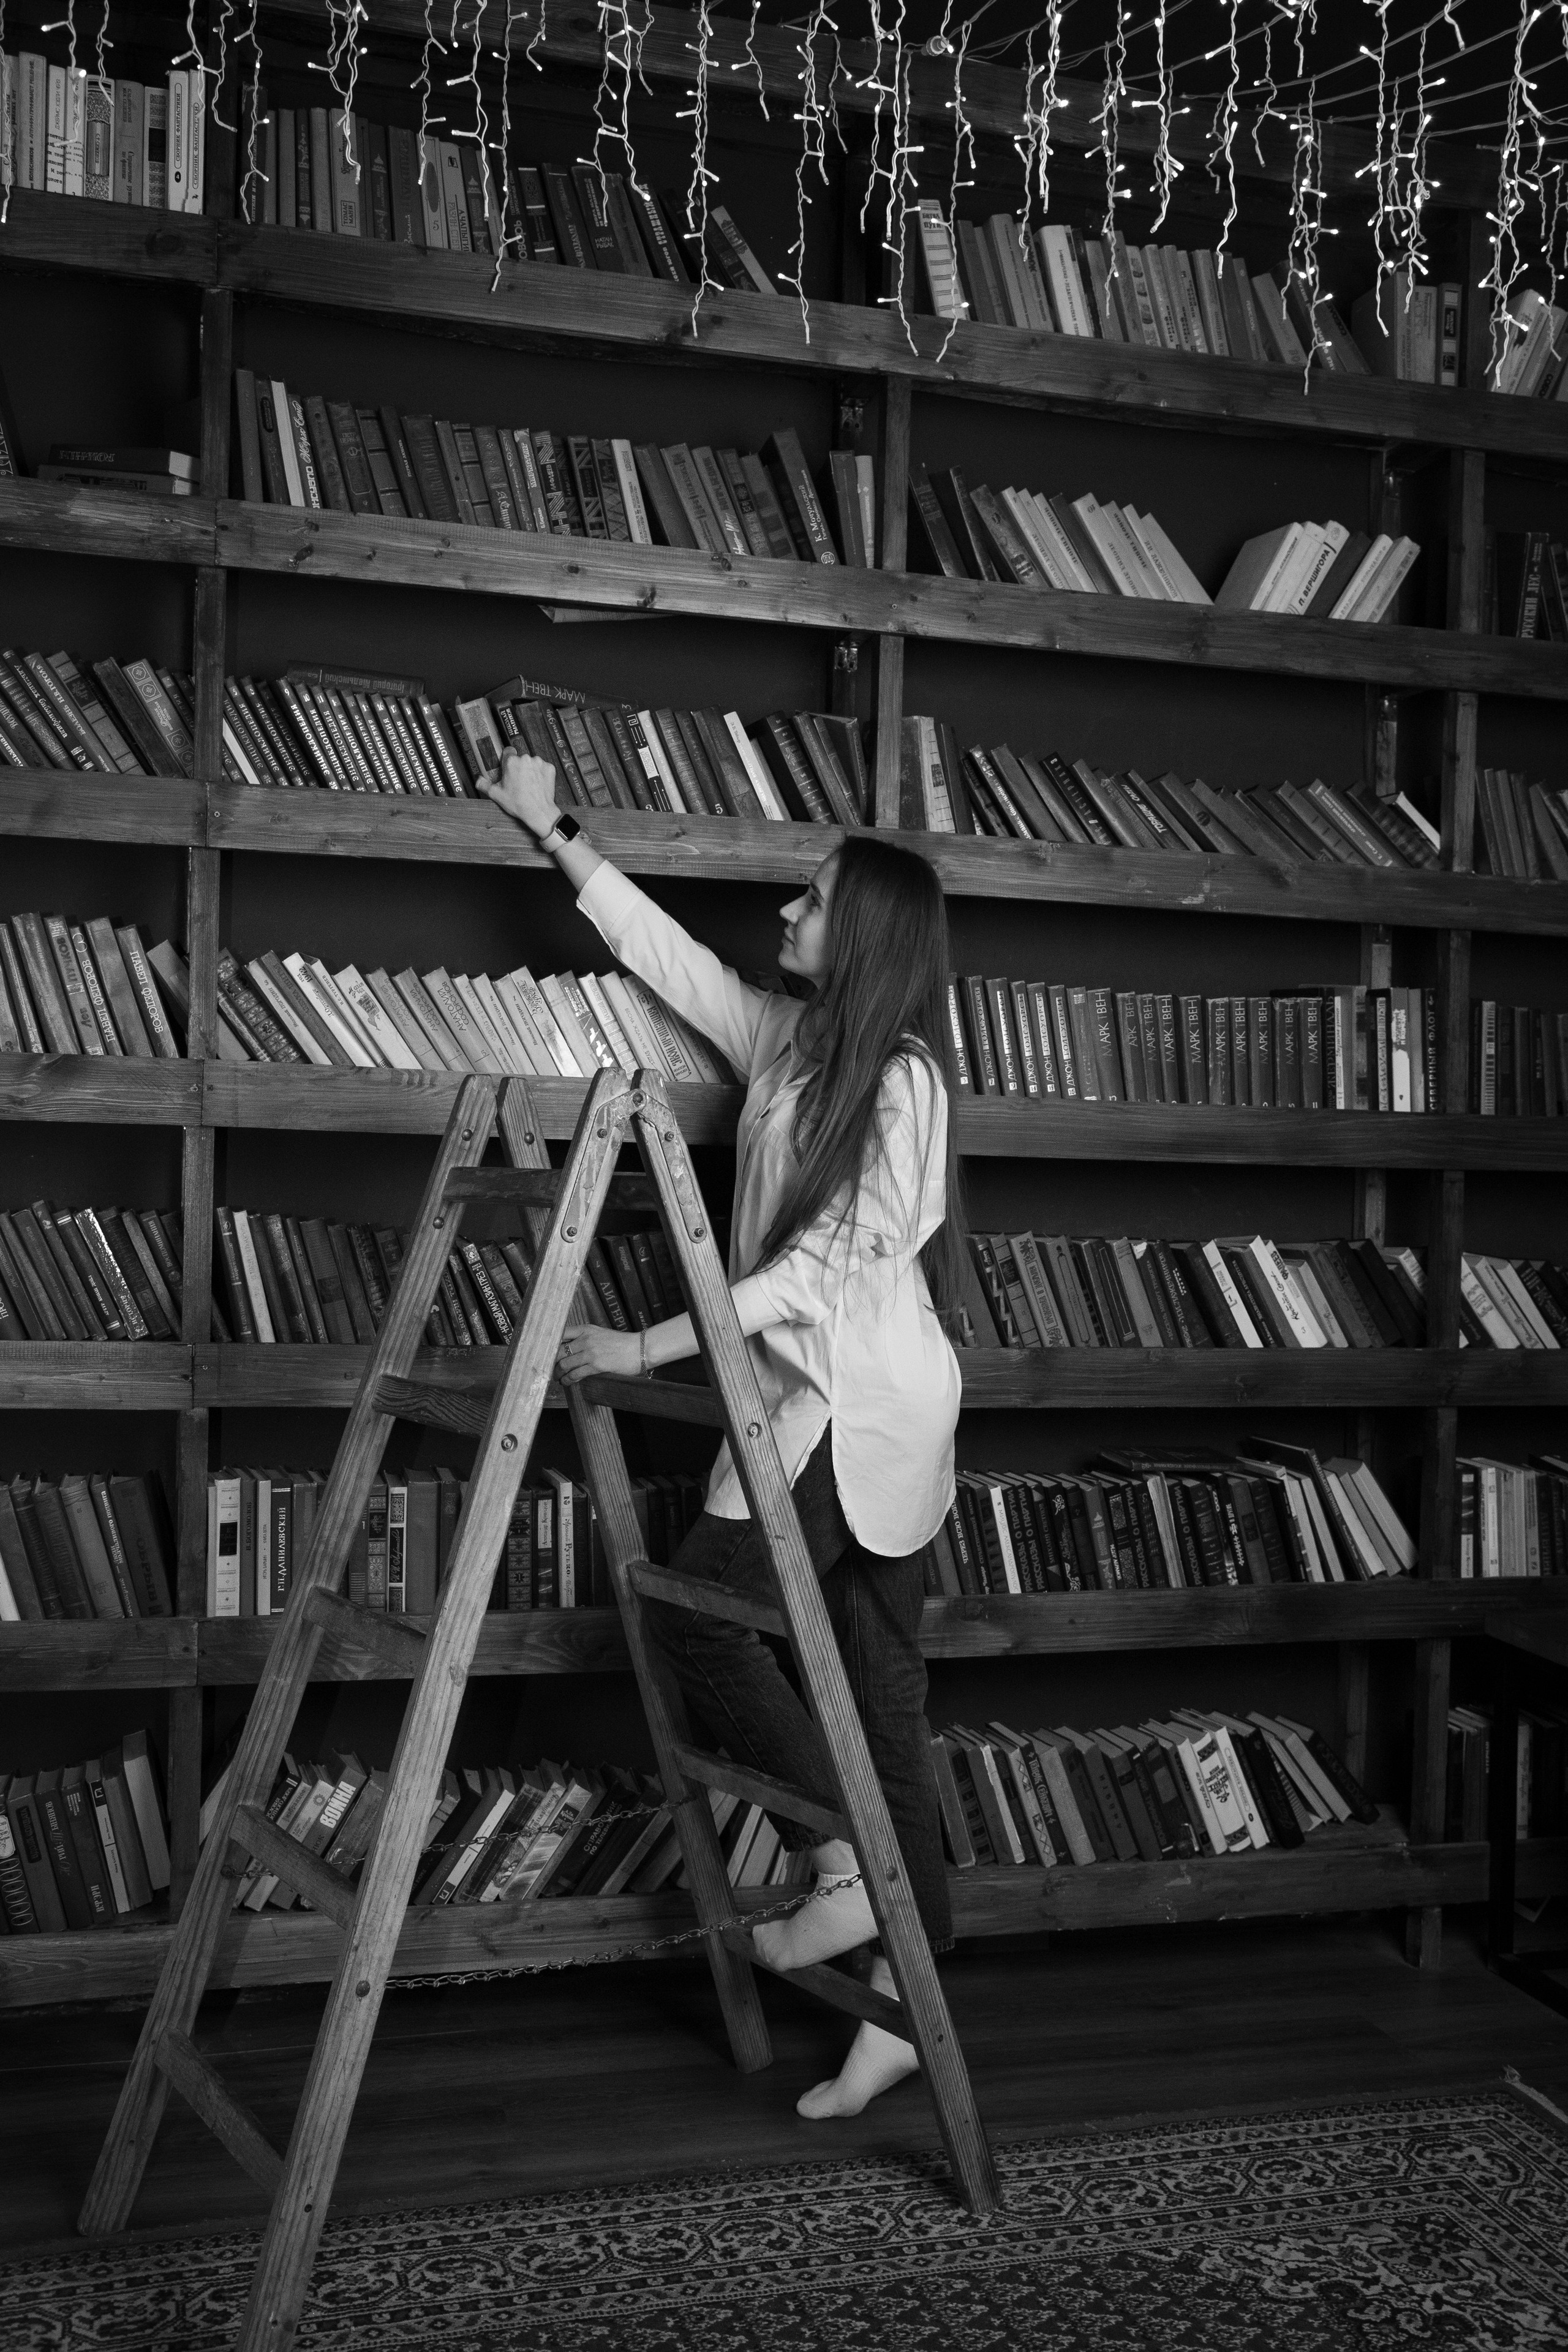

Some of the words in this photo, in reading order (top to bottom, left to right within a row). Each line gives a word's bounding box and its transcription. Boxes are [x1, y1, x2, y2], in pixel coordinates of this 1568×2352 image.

[398, 439, 407, 460] ЛЮБОВЬ
[799, 483, 820, 532] Мочульский
[1302, 548, 1331, 597] ВЕРШИГОРА
[524, 680, 551, 697] ТВЕН
[554, 686, 586, 704] МАРК
[62, 703, 86, 737] БОЛЕЗНЬ
[501, 710, 514, 736] НИКОЛАЙ
[506, 707, 519, 735] РЫЛЕНКОВ
[238, 703, 279, 774] ЭНЦИКЛОПЕДИЯ
[255, 701, 295, 774] ЭНЦИКЛОПЕДИЯ
[289, 704, 329, 777] ЭНЦИКЛОПЕДИЯ
[309, 708, 345, 782] ЭНЦИКЛОПЕДИЯ
[322, 710, 359, 783] ЭНЦИКЛОПЕДИЯ
[336, 714, 372, 786] ЭНЦИКЛОПЕДИЯ
[366, 718, 401, 791] ЭНЦИКЛОПЕДИЯ
[380, 717, 417, 791] ЭНЦИКЛОПЕДИЯ
[395, 720, 429, 793] ЭНЦИКЛОПЕДИЯ
[412, 722, 444, 795] ЭНЦИКЛОПЕДИЯ
[429, 720, 462, 794] ЭНЦИКЛОПЕДИЯ
[56, 937, 78, 984] ПУЧКОВ
[300, 965, 314, 982] 1942
[82, 960, 105, 1007] ФЕДОРОВ
[129, 949, 146, 984] ПАВЕЛ
[141, 985, 164, 1033] ФЕДОРОВ
[322, 973, 339, 997] ТУРГЕНЕВ
[383, 977, 412, 1021] СОФРОНОВ
[380, 984, 409, 1028] АНАТОЛИЙ
[437, 988, 466, 1033] АНАТОЛИЙ
[442, 981, 469, 1027] СОФРОНОВ
[1095, 992, 1108, 1020] ТВЕН
[1142, 997, 1153, 1025] ТВЕН
[1161, 998, 1172, 1025] ТВЕН
[1187, 1000, 1199, 1027] ТВЕН
[1215, 1002, 1225, 1028] ТВЕН
[1235, 1001, 1245, 1028] ТВЕН
[1257, 1001, 1267, 1028] ТВЕН
[1284, 1004, 1294, 1029] ТВЕН
[1307, 1001, 1317, 1028] ТВЕН
[97, 1008, 115, 1043] ПАВЕЛ
[624, 1007, 635, 1023] ВЕСНА
[633, 1024, 644, 1041] ЖДАТЬ
[644, 1050, 654, 1065] БУДЕТ
[1098, 1022, 1113, 1057] МАРК
[1427, 1009, 1436, 1041] ФЛОТ
[1144, 1028, 1158, 1061] МАРК
[1162, 1028, 1175, 1062] МАРК
[1188, 1030, 1202, 1063] МАРК
[1215, 1031, 1226, 1066] МАРК
[1235, 1031, 1246, 1064] МАРК
[1257, 1031, 1268, 1064] МАРК
[1284, 1033, 1294, 1065] МАРК
[1307, 1031, 1317, 1064] МАРК
[956, 1049, 968, 1076] ДЖОН
[983, 1050, 994, 1077] ДЖОН
[1005, 1054, 1016, 1081] ДЖОН
[1025, 1057, 1036, 1084] ДЖОН
[1043, 1056, 1055, 1086] ДЖОН
[1065, 1060, 1075, 1088] ДЖОН
[1427, 1047, 1438, 1110] СЕВЕРНЫЙ
[148, 1221, 172, 1268] ВОСПОМИНАНИЯ
[475, 1271, 488, 1286] ГРЕЗ
[481, 1285, 500, 1313] МАГАЗИН
[492, 1310, 508, 1333] НОВЫЙ
[1007, 1490, 1022, 1529] ПАРТИИ
[1017, 1488, 1032, 1527] ПАРТИИ
[1125, 1487, 1139, 1526] ПАРТИИ
[1173, 1485, 1189, 1525] ПАРТИИ
[955, 1520, 964, 1539] ВСЮ
[276, 1507, 285, 1591] Г.П.ДАНИЛЕВСКИЙ
[959, 1540, 969, 1564] ЧЕРЕЗ
[1028, 1540, 1045, 1591] РАССКАЗЫ
[1044, 1533, 1055, 1564] МИХАИЛ
[1134, 1537, 1150, 1587] РАССКАЗЫ
[1185, 1536, 1201, 1586] РАССКАЗЫ
[1017, 1541, 1033, 1593] РАССКАЗЫ
[318, 1781, 358, 1828] ВОЙНА
[584, 1800, 617, 1852] СПРАВОНИК
